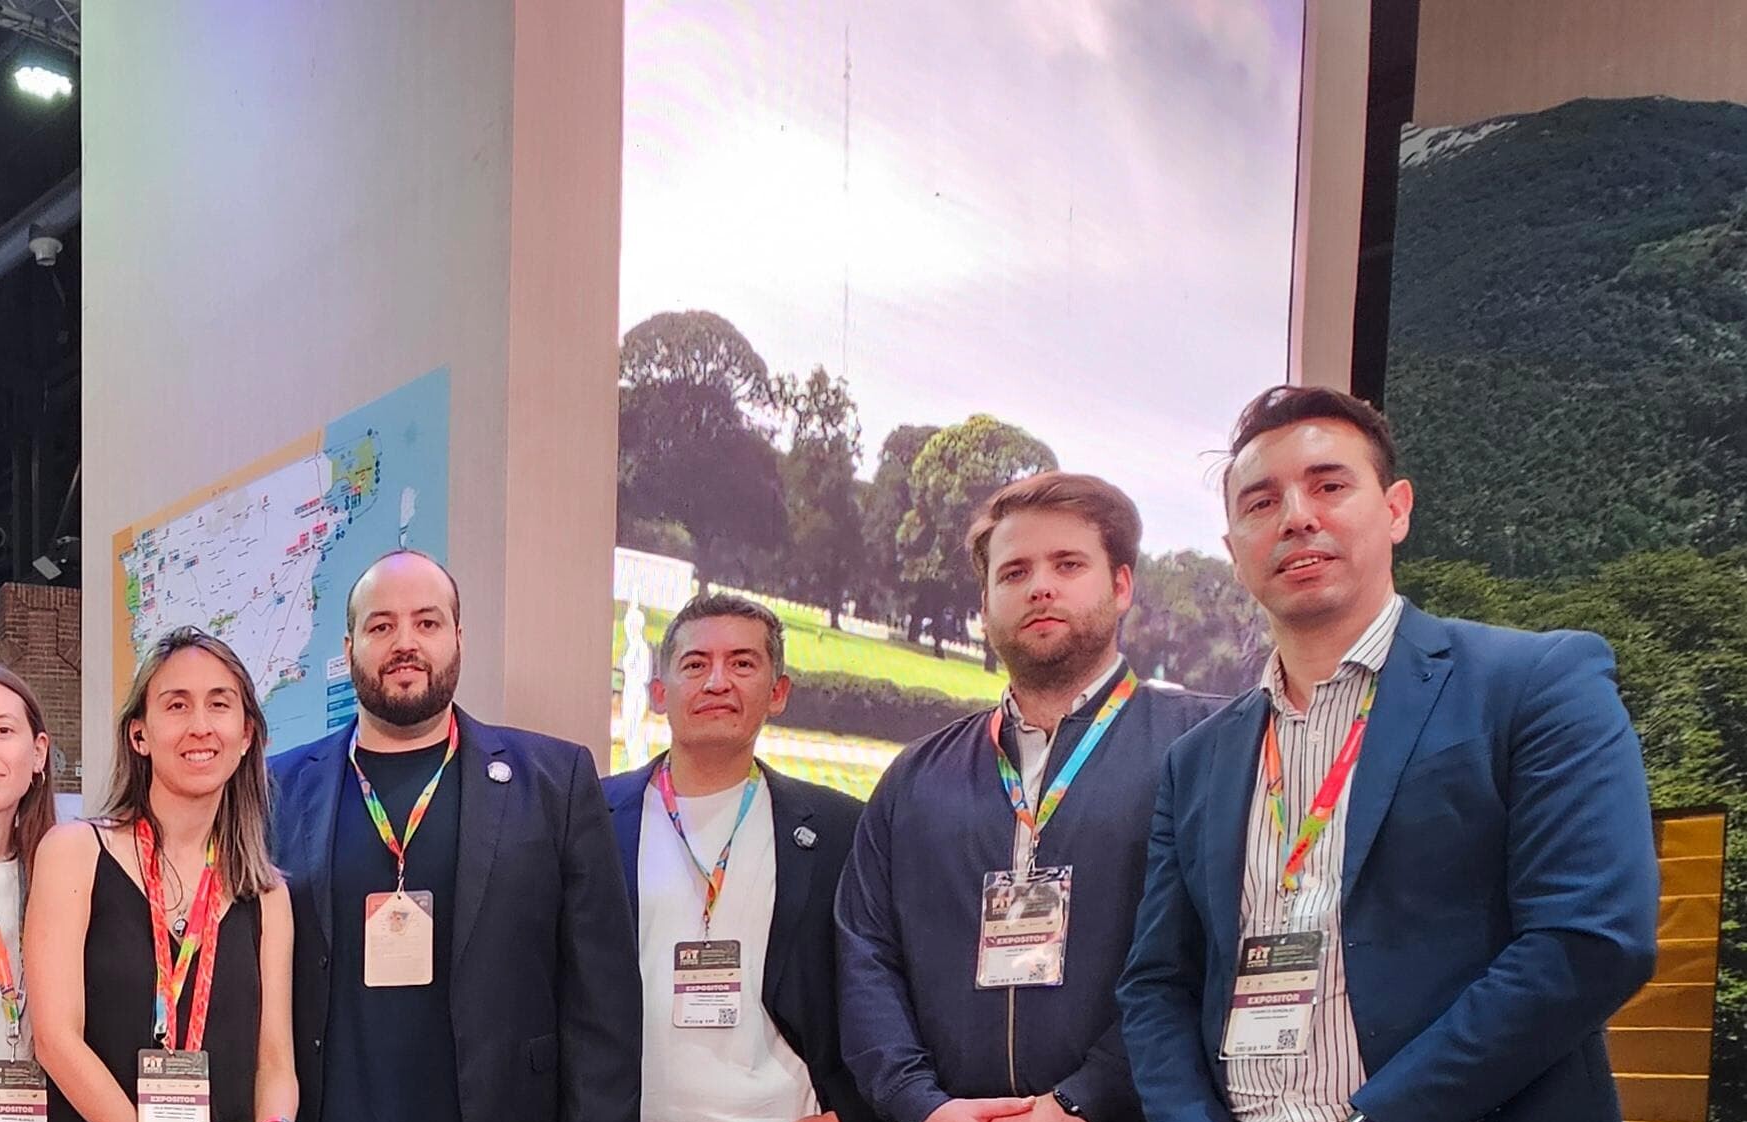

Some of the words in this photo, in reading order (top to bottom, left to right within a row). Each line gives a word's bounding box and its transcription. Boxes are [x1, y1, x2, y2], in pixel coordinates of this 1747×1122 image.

[996, 934, 1047, 944] EXPOSITOR
[685, 984, 730, 992] EXPOSITOR
[1247, 993, 1301, 1005] EXPOSITOR
[150, 1095, 196, 1104] EXPOSITOR
